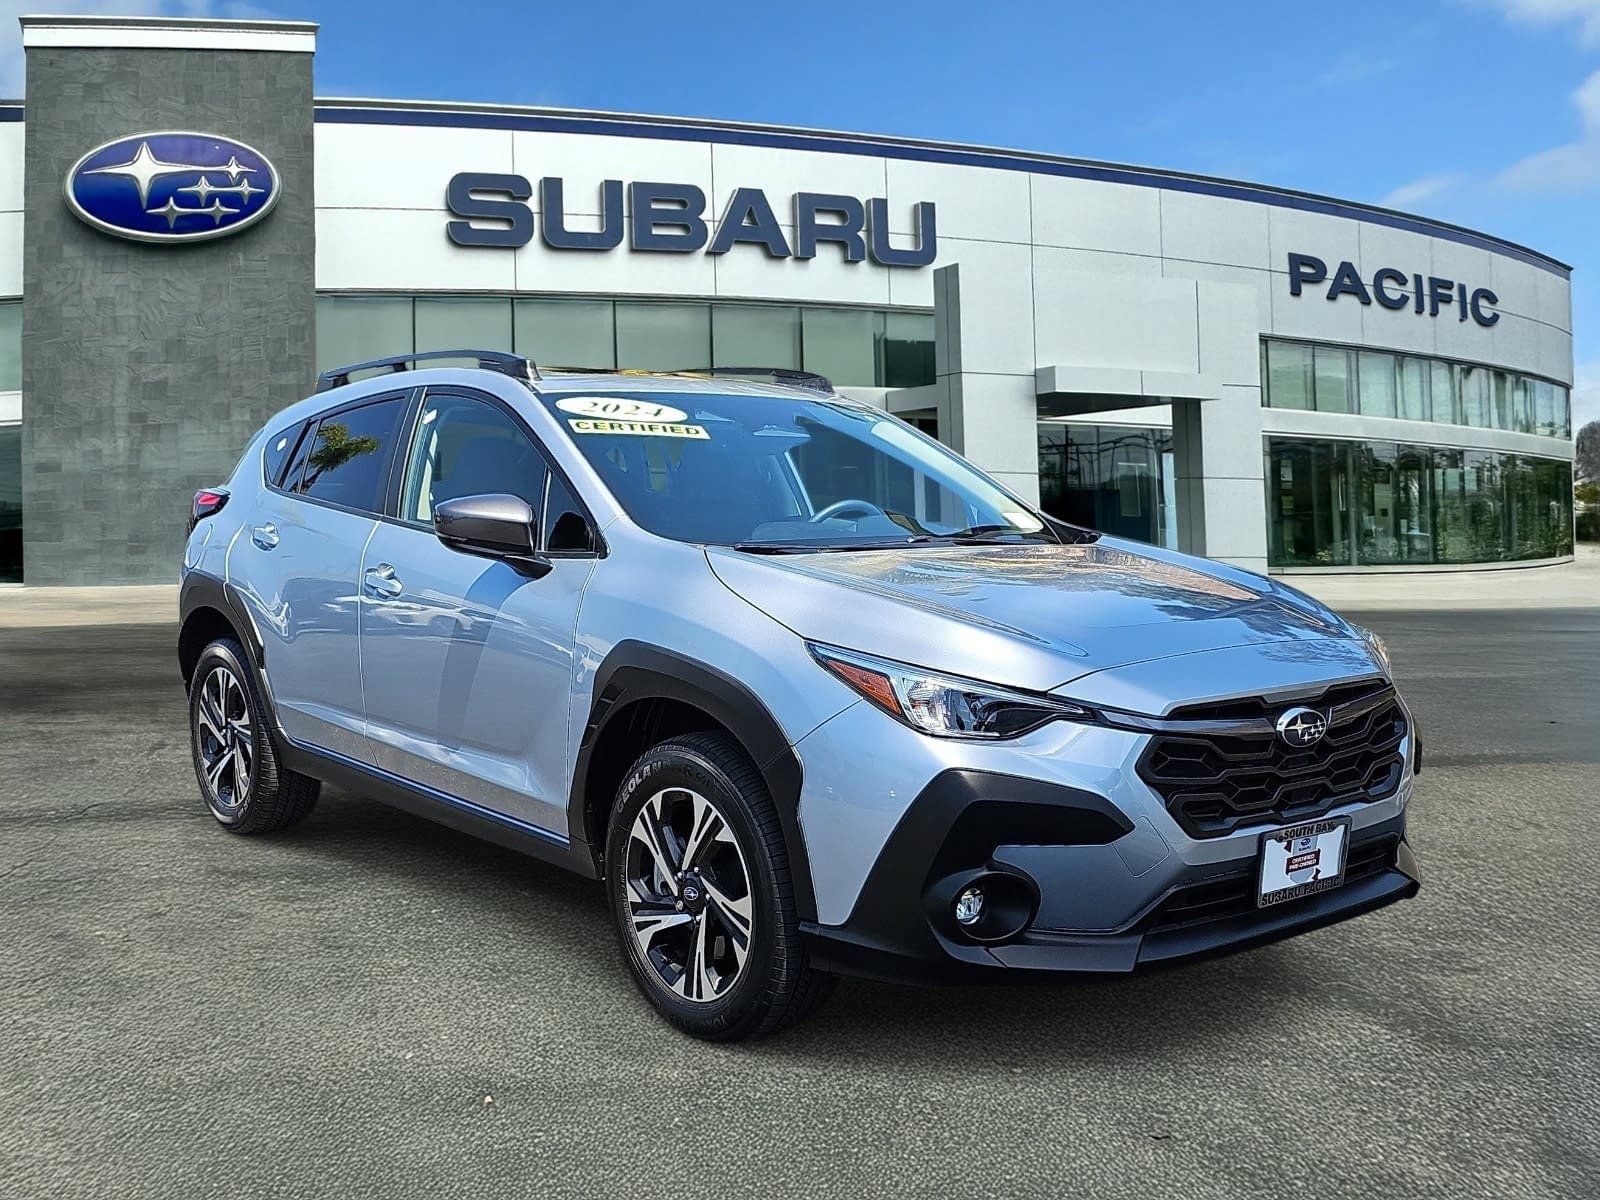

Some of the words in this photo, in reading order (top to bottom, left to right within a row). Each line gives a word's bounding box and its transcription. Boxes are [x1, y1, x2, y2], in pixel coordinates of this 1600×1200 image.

[447, 172, 937, 267] SUBARU
[1288, 252, 1499, 327] PACIFIC
[582, 401, 663, 417] 2024
[575, 421, 700, 435] CERTIFIED
[1284, 826, 1314, 841] SOUTH
[1315, 821, 1332, 833] BAY
[1261, 887, 1302, 906] SUBARU
